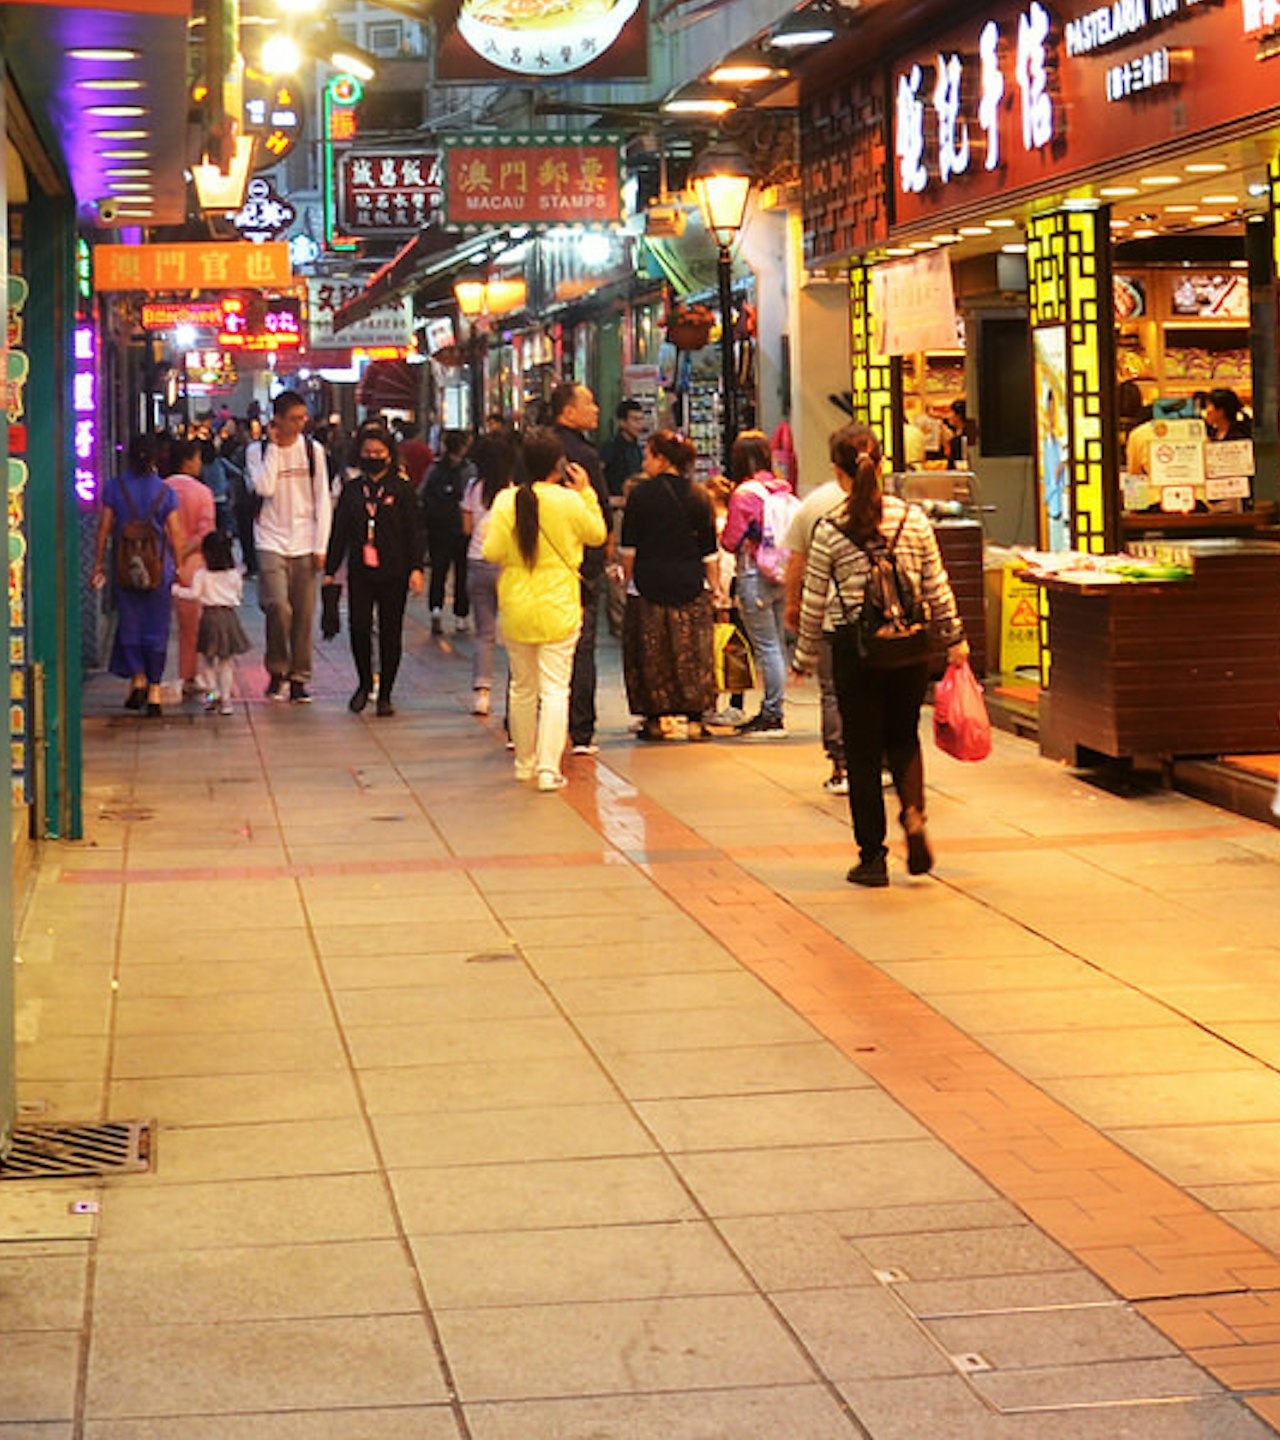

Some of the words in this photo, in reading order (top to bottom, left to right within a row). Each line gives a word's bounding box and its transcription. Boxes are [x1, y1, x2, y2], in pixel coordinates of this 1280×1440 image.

[457, 157, 607, 194] 澳門郵票
[466, 196, 525, 210] MACAU
[538, 195, 606, 209] STAMPS
[110, 249, 276, 282] 澳門官也
